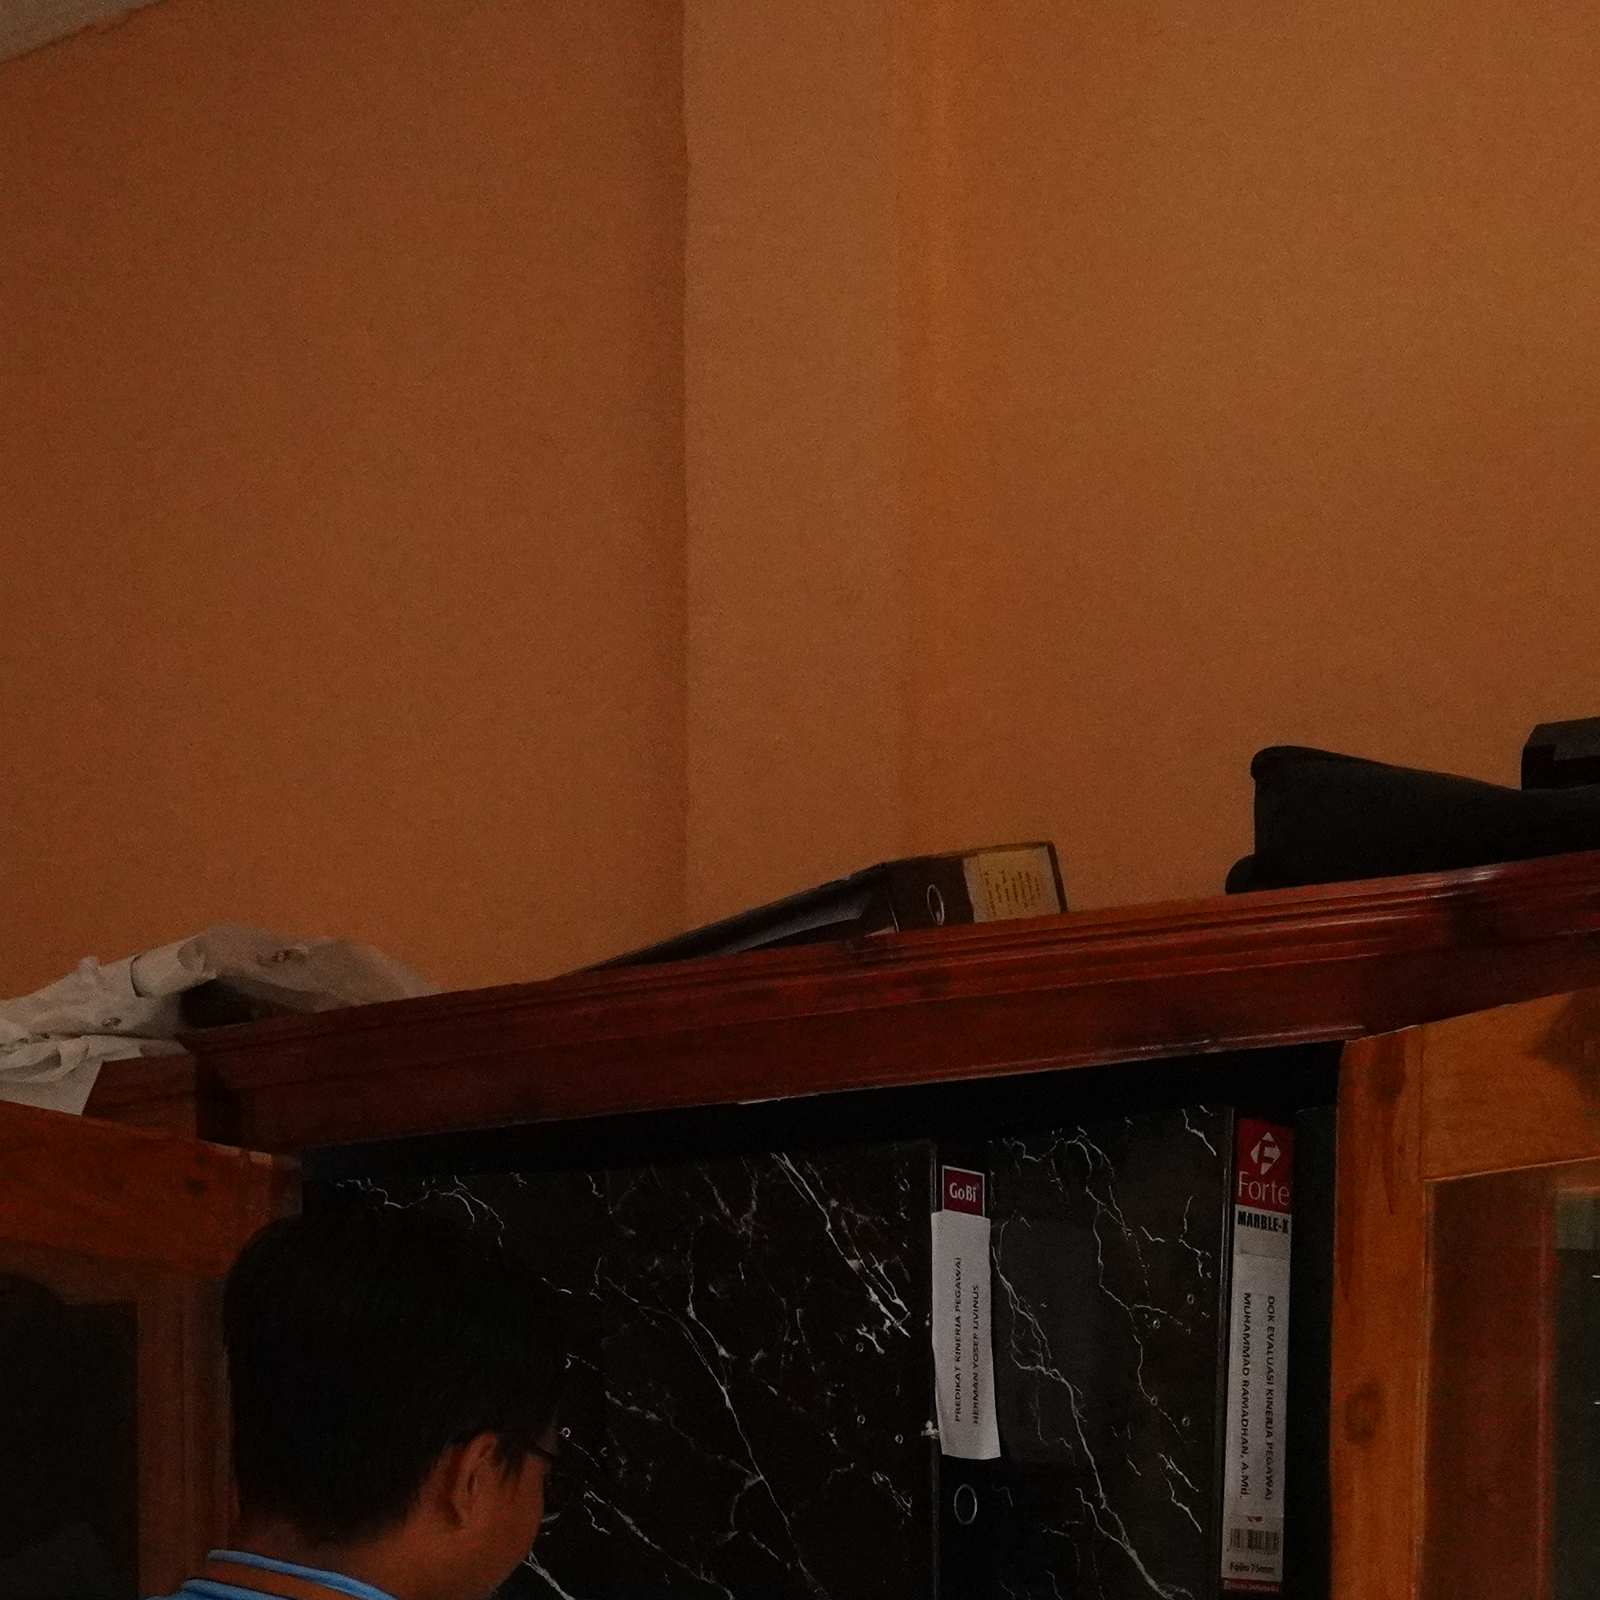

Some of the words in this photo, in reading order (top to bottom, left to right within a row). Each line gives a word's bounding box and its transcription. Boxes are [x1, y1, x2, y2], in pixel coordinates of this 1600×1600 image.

[950, 1183, 978, 1202] GoBi
[1238, 1169, 1290, 1206] Forte
[1238, 1212, 1288, 1233] MARBLE-X
[1266, 1296, 1275, 1321] DOK
[1242, 1292, 1251, 1376] MUHAMMAD
[1265, 1326, 1274, 1385] EVALUASI
[1265, 1389, 1274, 1438] KINERJA
[1264, 1442, 1273, 1500] PEGAWAI
